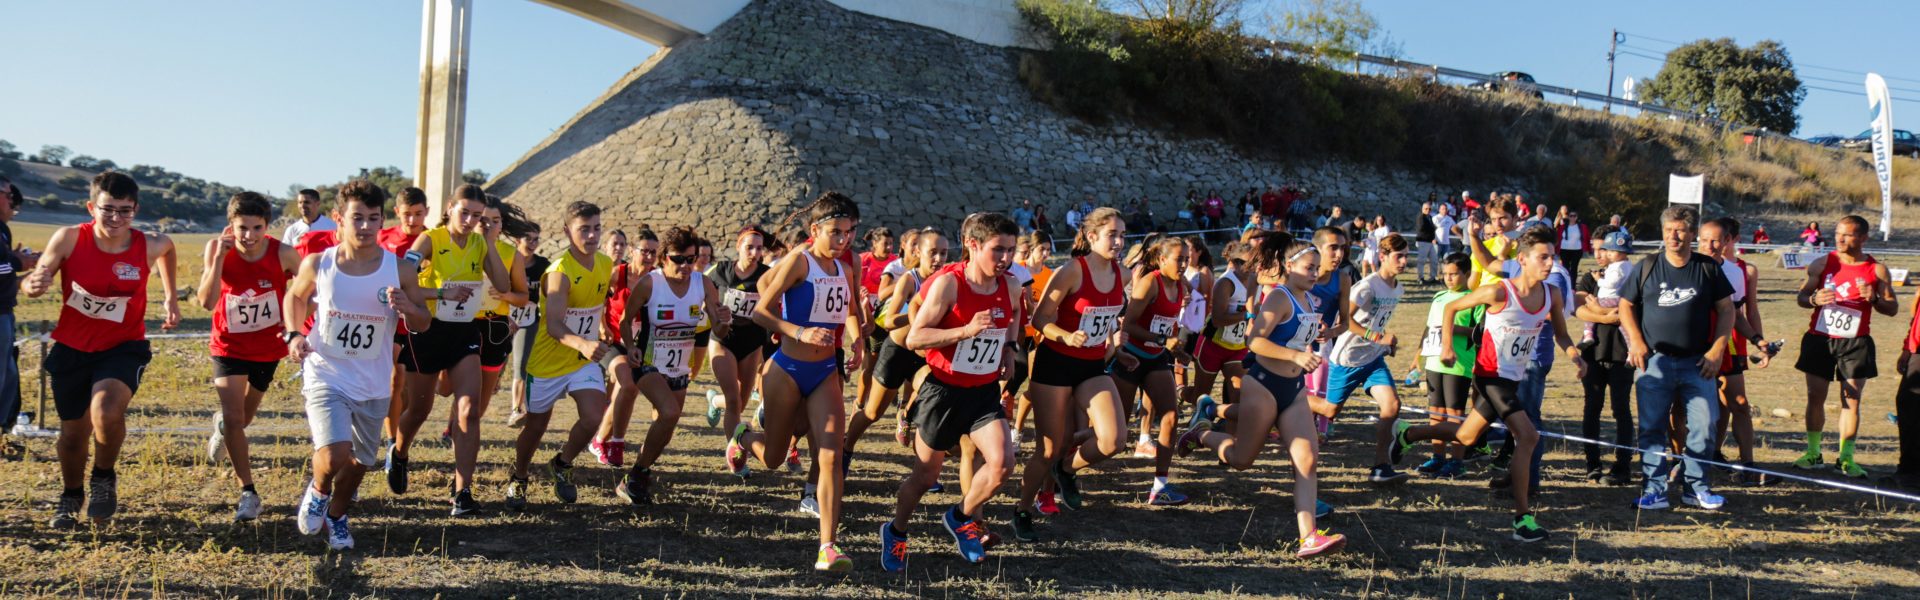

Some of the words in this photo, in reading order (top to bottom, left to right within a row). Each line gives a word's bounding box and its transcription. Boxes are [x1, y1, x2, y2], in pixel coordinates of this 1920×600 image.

[82, 296, 117, 314] 576
[732, 297, 757, 316] 547
[825, 286, 849, 313] 654
[238, 301, 272, 325] 574
[511, 307, 531, 321] 474
[1826, 313, 1853, 331] 568
[577, 315, 594, 335] 12
[336, 322, 375, 349] 463
[968, 338, 1000, 364] 572
[1510, 336, 1536, 357] 640
[665, 349, 683, 368] 21
